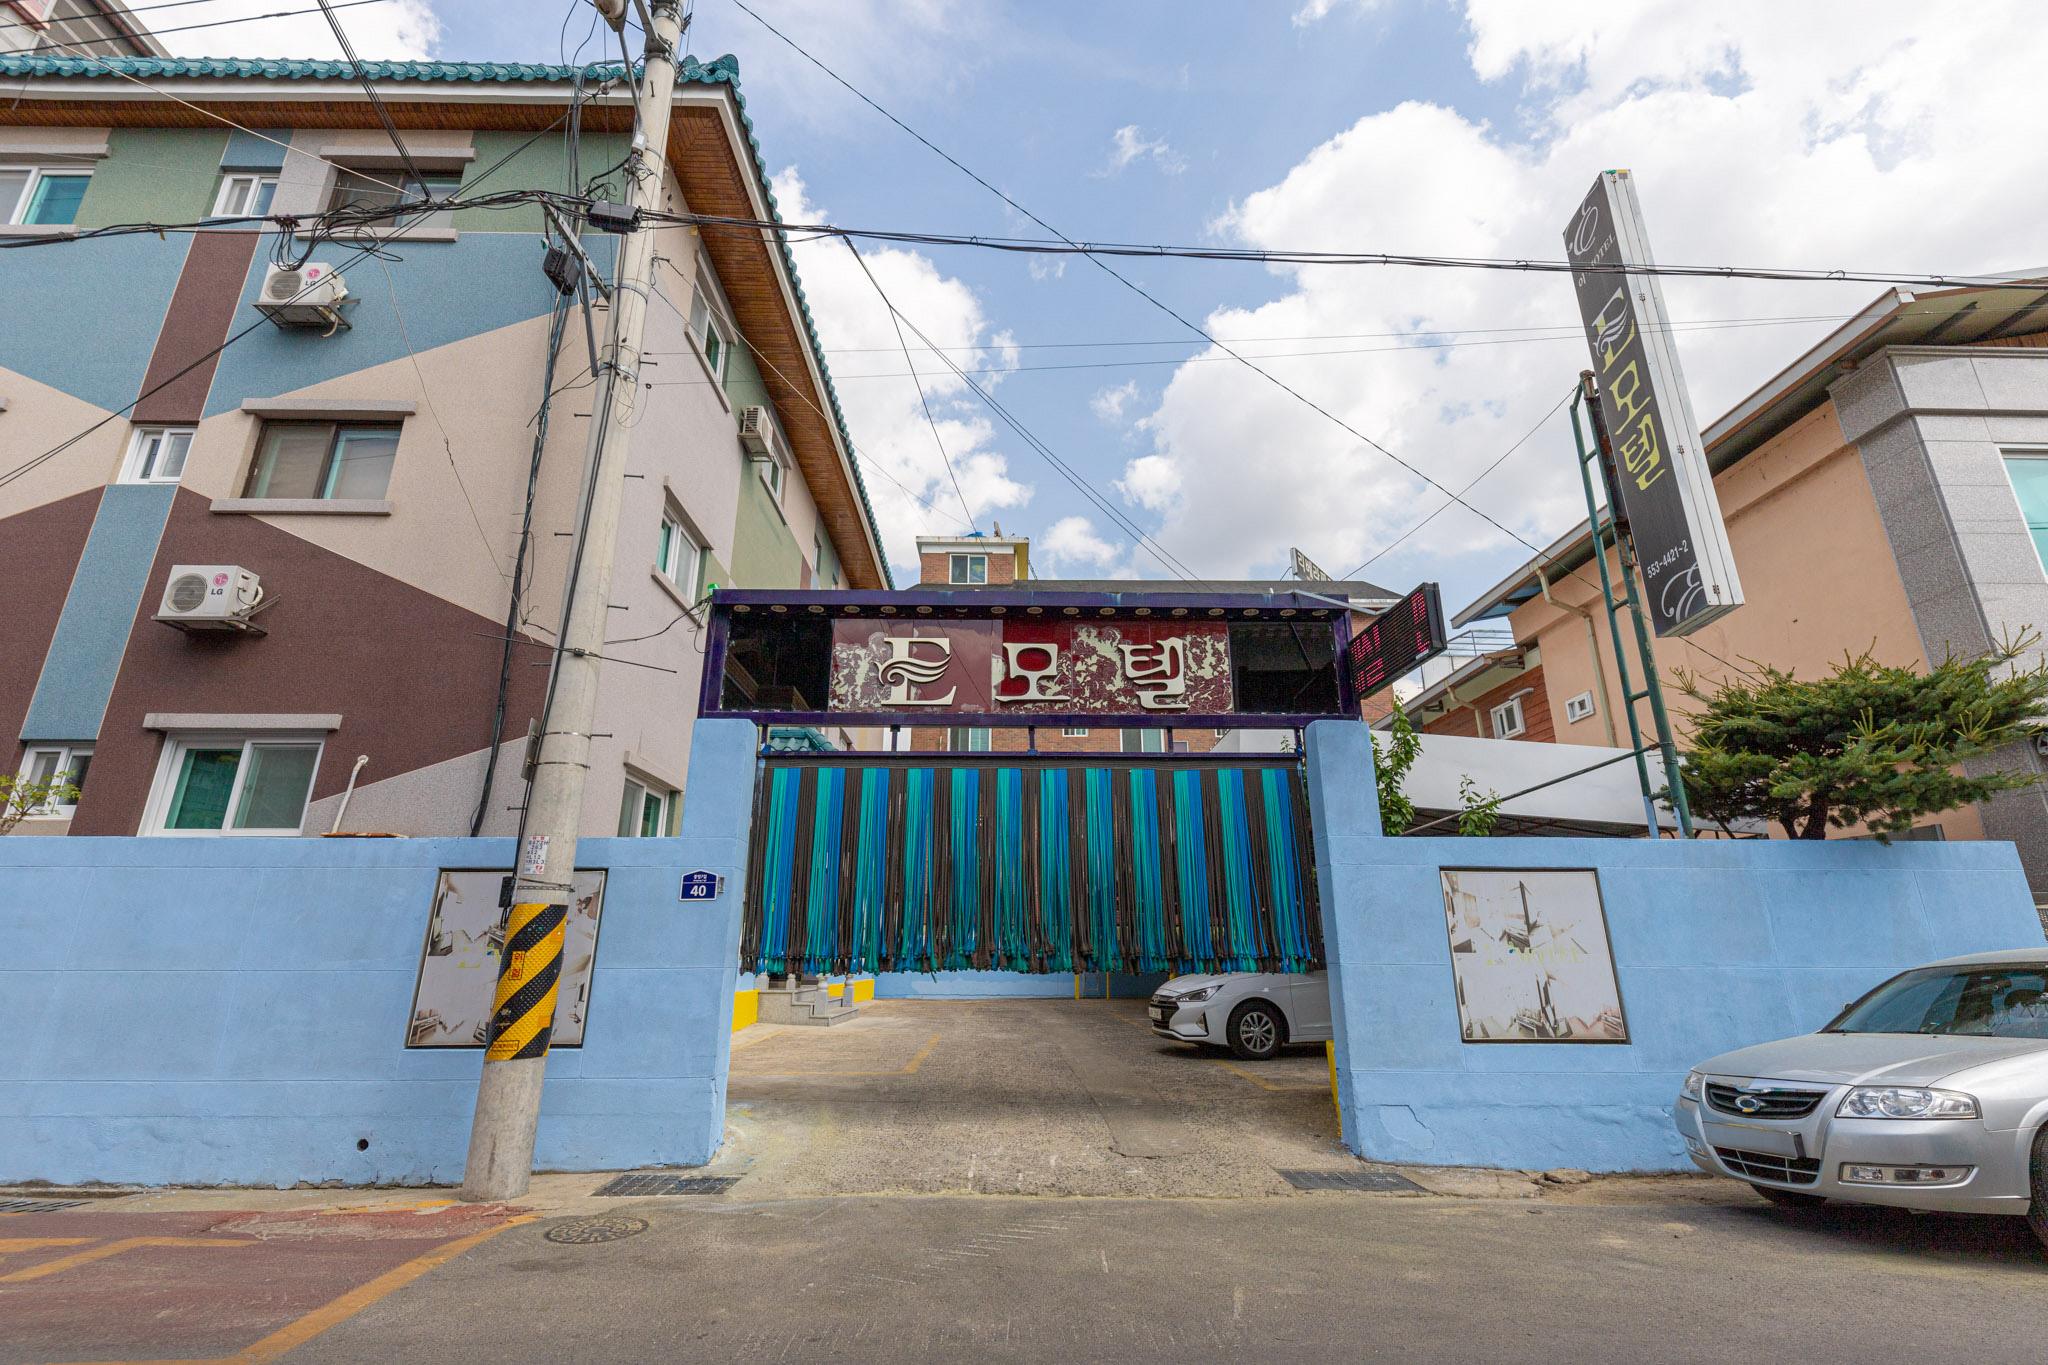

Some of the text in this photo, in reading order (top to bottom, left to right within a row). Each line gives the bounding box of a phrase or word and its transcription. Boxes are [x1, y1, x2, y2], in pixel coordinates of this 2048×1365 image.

[1587, 233, 1617, 276] OTEL
[210, 588, 224, 596] LG
[690, 884, 707, 897] 40
